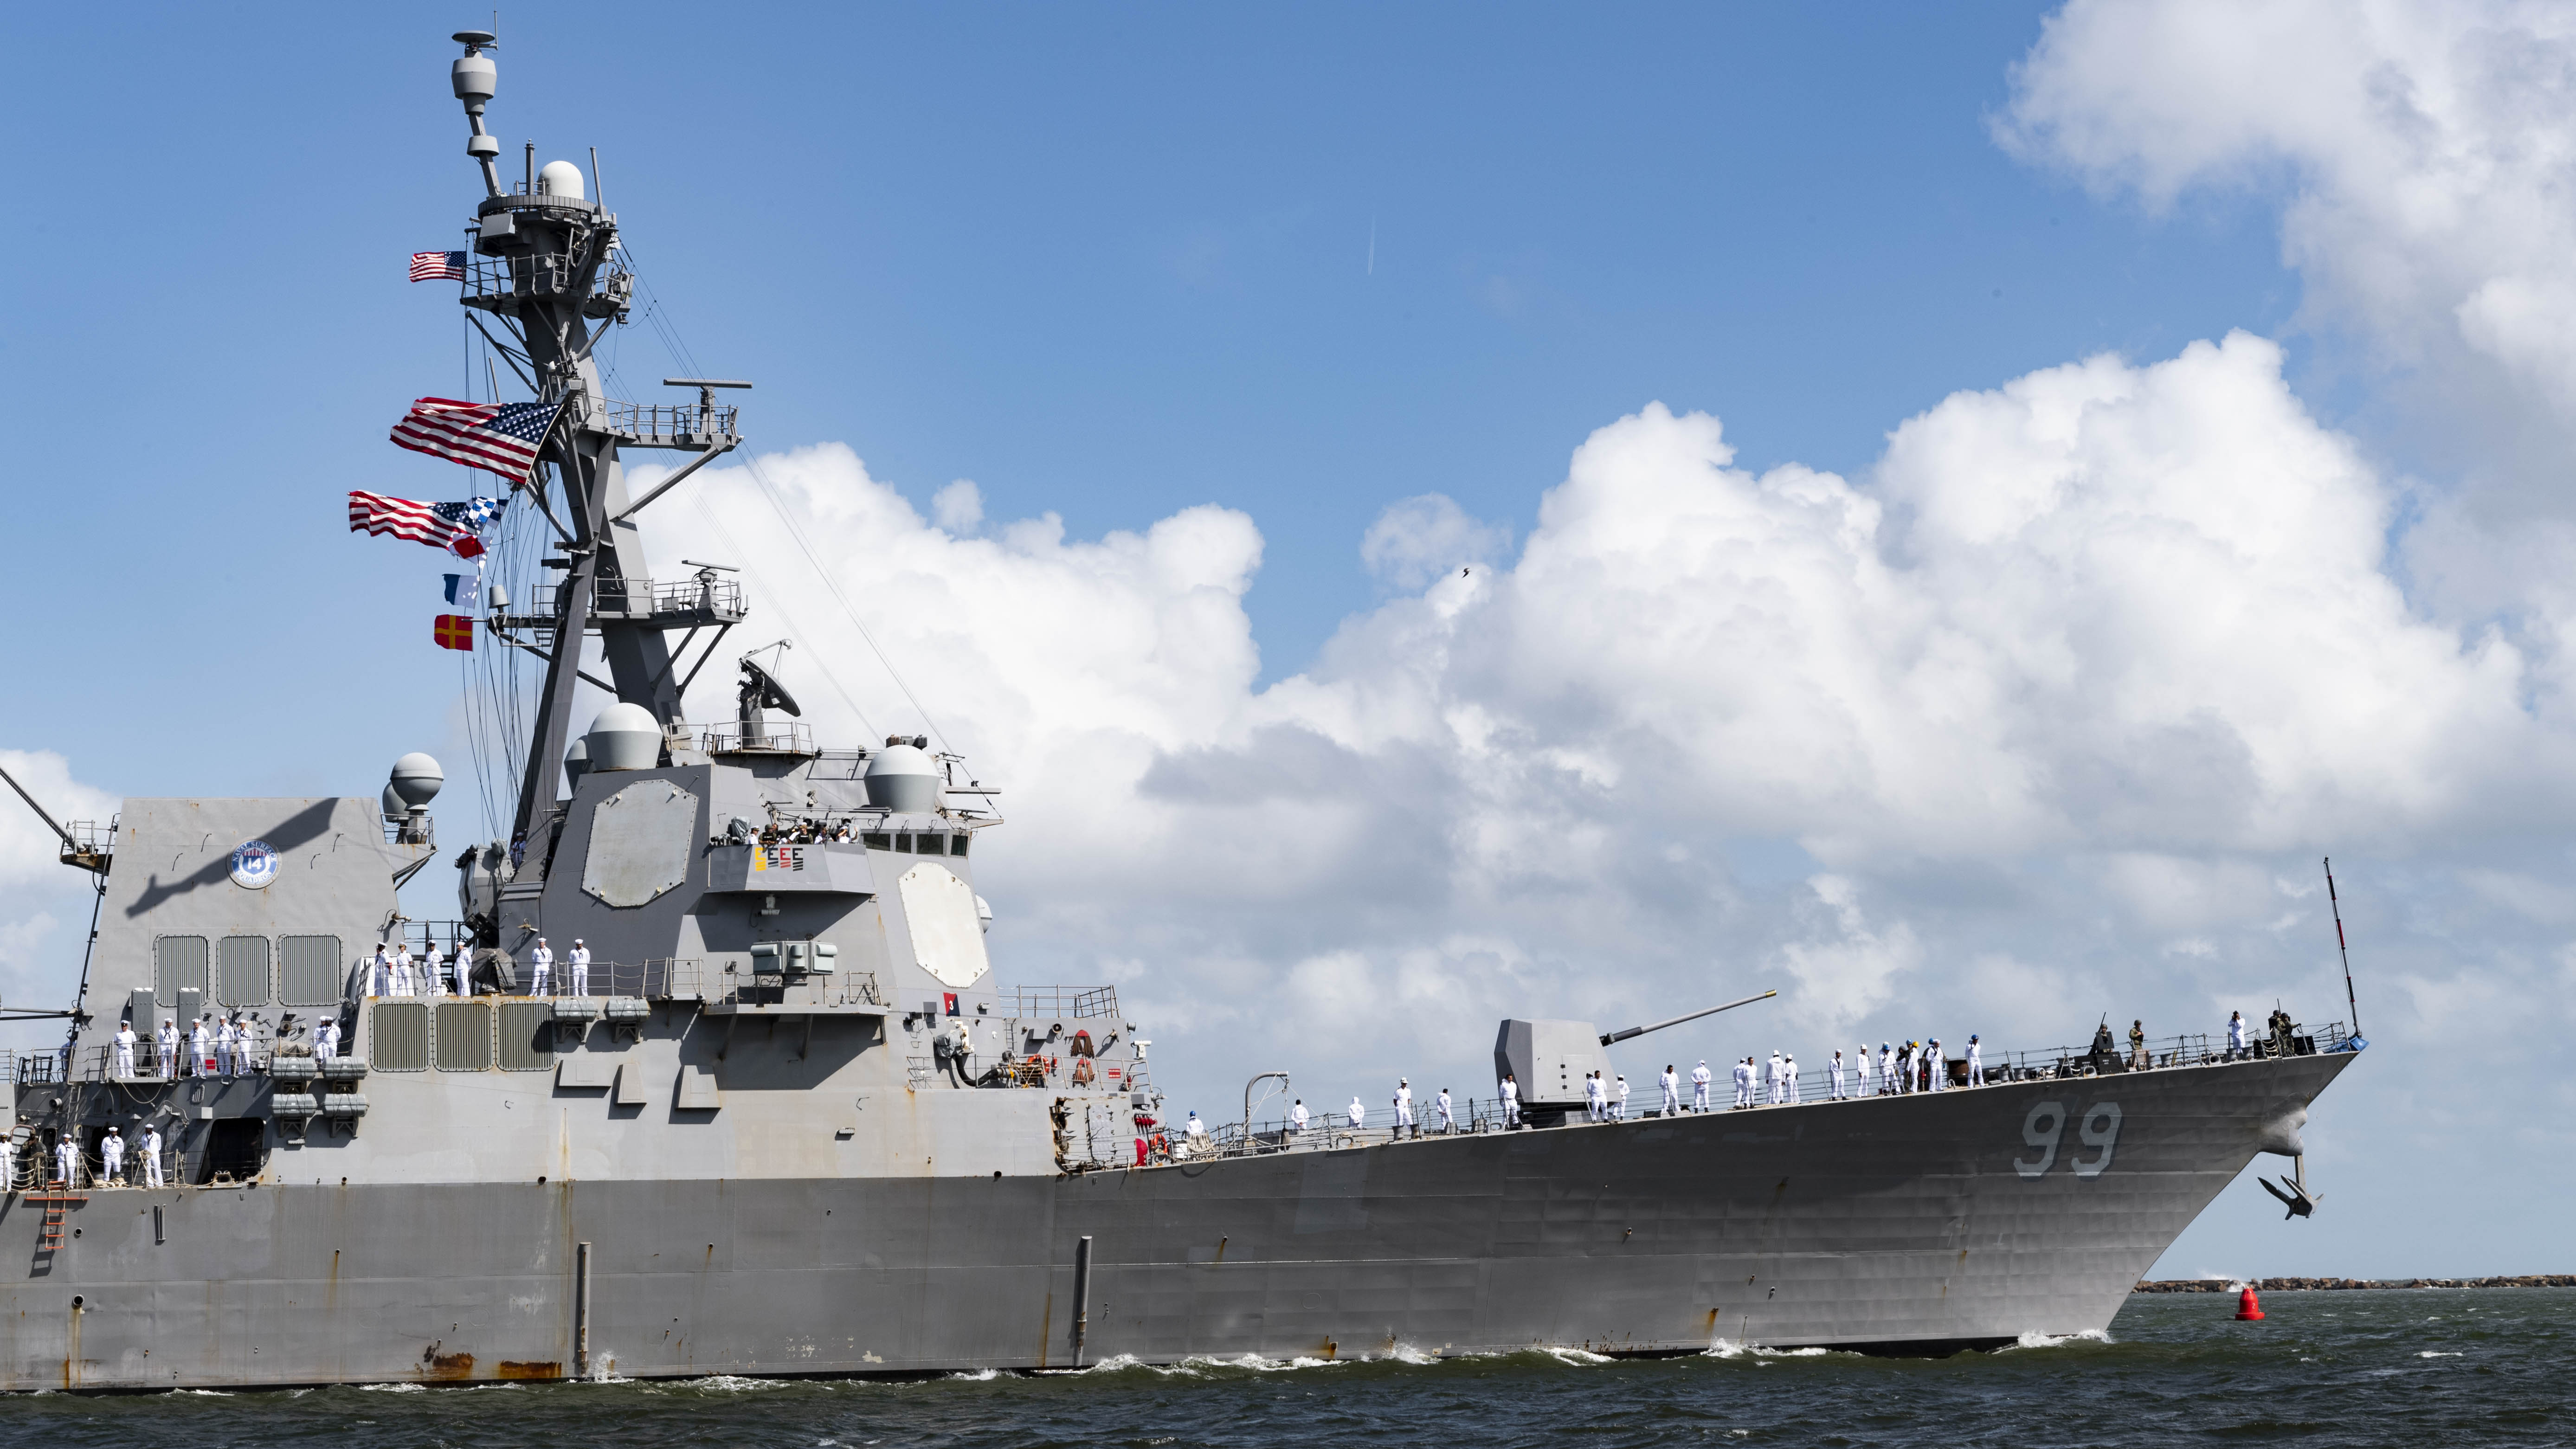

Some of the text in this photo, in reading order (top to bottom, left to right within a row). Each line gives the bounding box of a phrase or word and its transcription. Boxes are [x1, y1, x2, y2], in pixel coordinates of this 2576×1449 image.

[233, 842, 276, 862] NAVAL SURFACE
[247, 857, 262, 869] 14
[236, 869, 272, 883] SQUADRON
[949, 1000, 954, 1011] 3
[2013, 1101, 2123, 1177] 99
